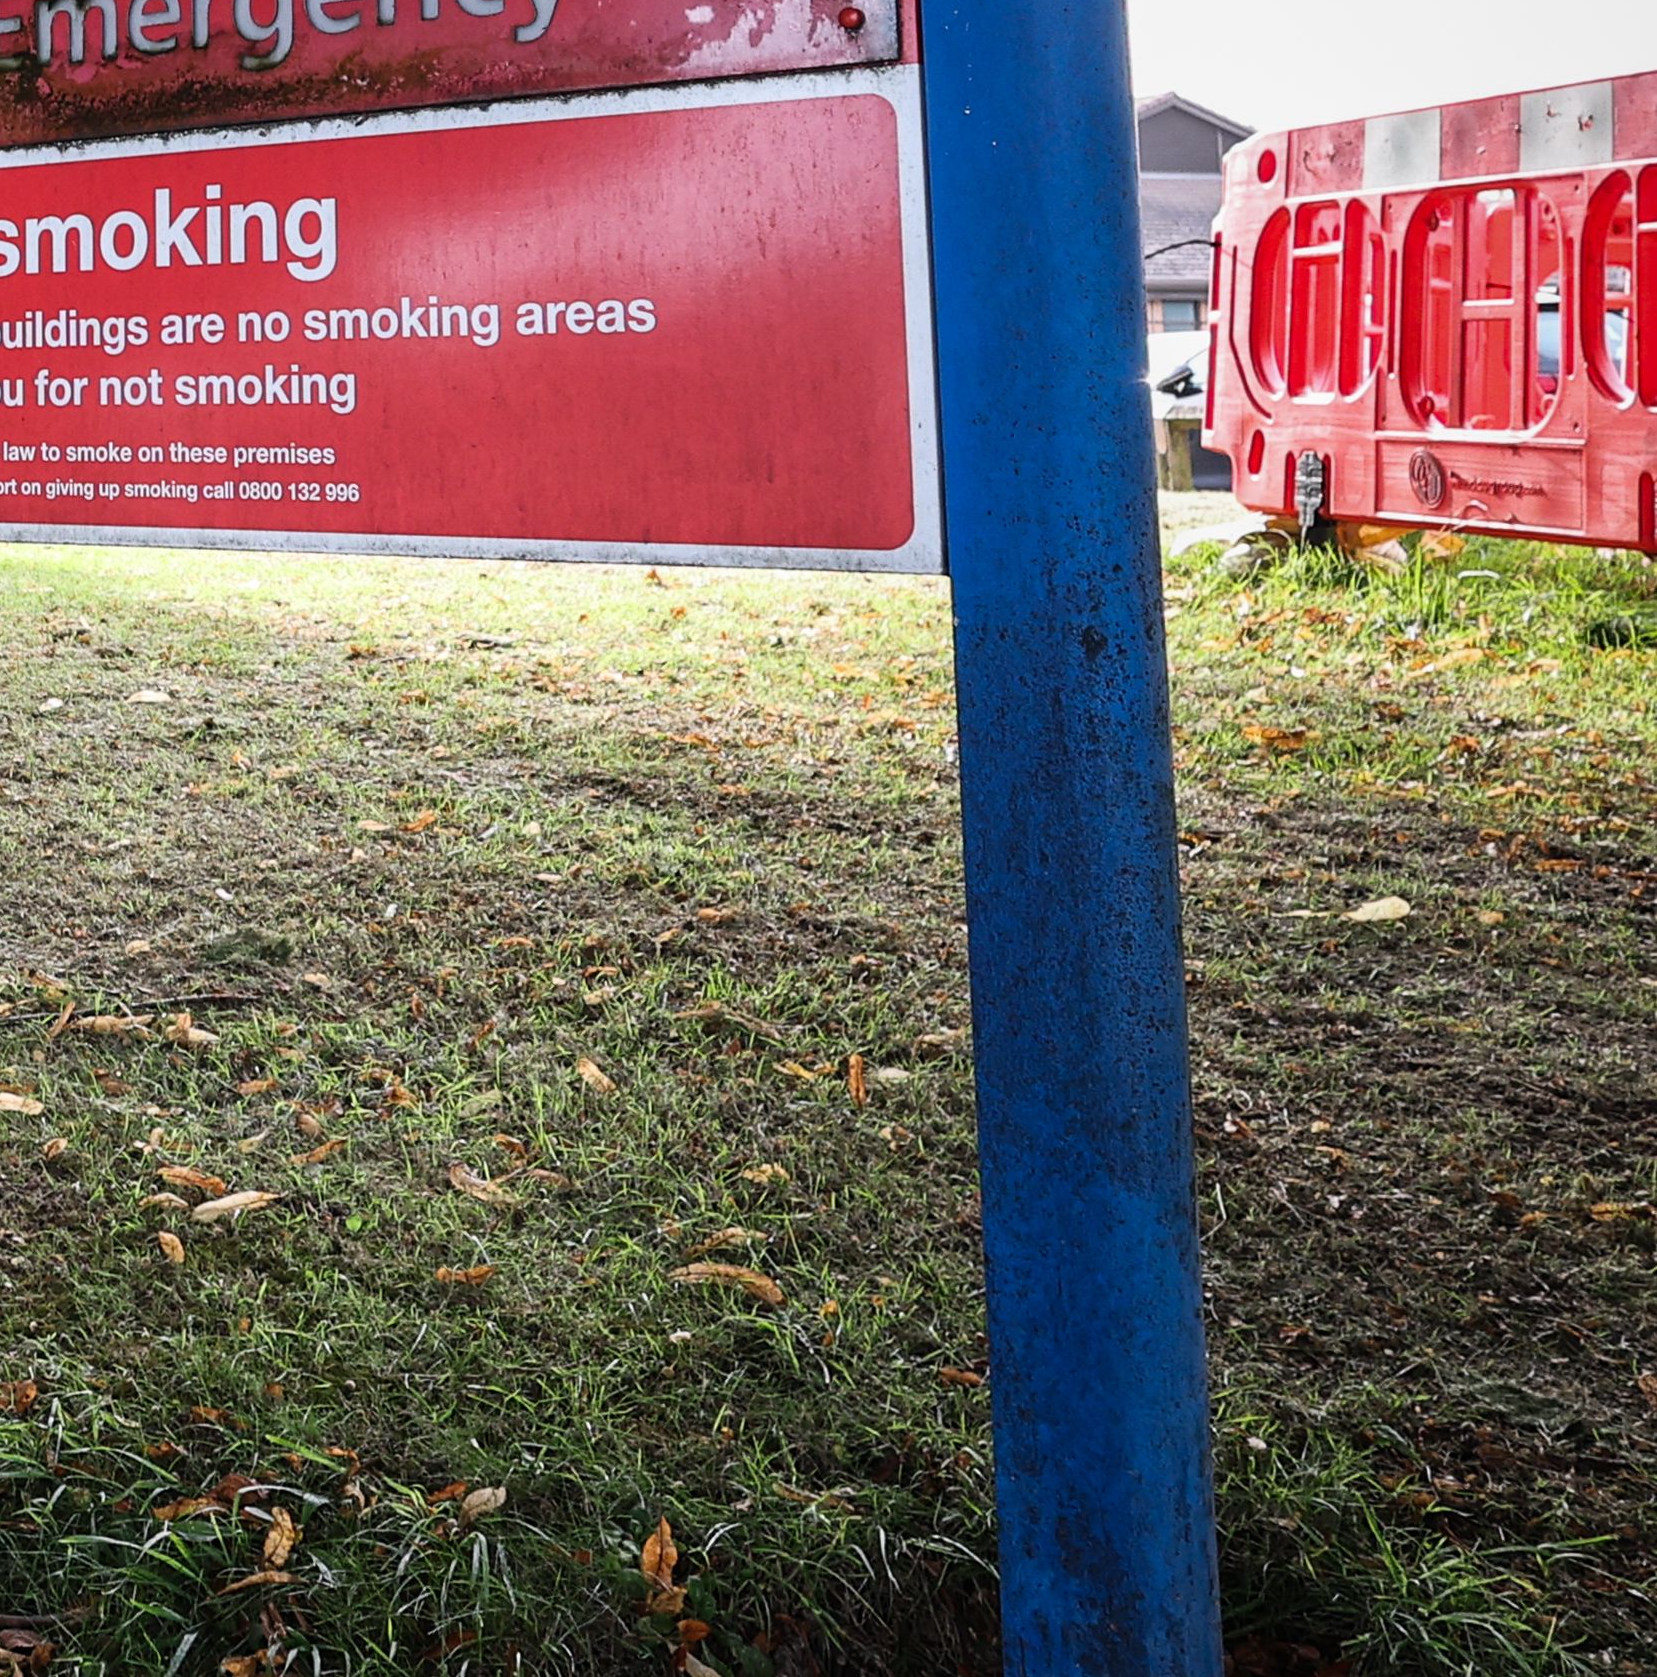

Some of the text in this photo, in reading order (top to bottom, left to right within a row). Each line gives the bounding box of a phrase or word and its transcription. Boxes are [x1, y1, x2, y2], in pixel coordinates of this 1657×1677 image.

[160, 312, 225, 344] are
[238, 309, 290, 342] no
[303, 296, 500, 347] smoking
[515, 297, 657, 336] areas
[34, 369, 89, 407] for
[100, 369, 163, 407] not
[174, 364, 357, 415] smoking
[3, 441, 36, 462] law
[40, 443, 61, 462] to
[65, 441, 133, 463] smoke
[137, 445, 164, 463] on
[169, 442, 228, 464] these
[233, 443, 336, 468] premises
[21, 481, 41, 495] on
[45, 479, 94, 500] giving
[99, 482, 120, 500] up
[124, 480, 199, 503] smoking
[202, 481, 235, 500] call
[238, 481, 283, 500] 0800
[287, 483, 321, 502] 132
[325, 483, 361, 503] 996
